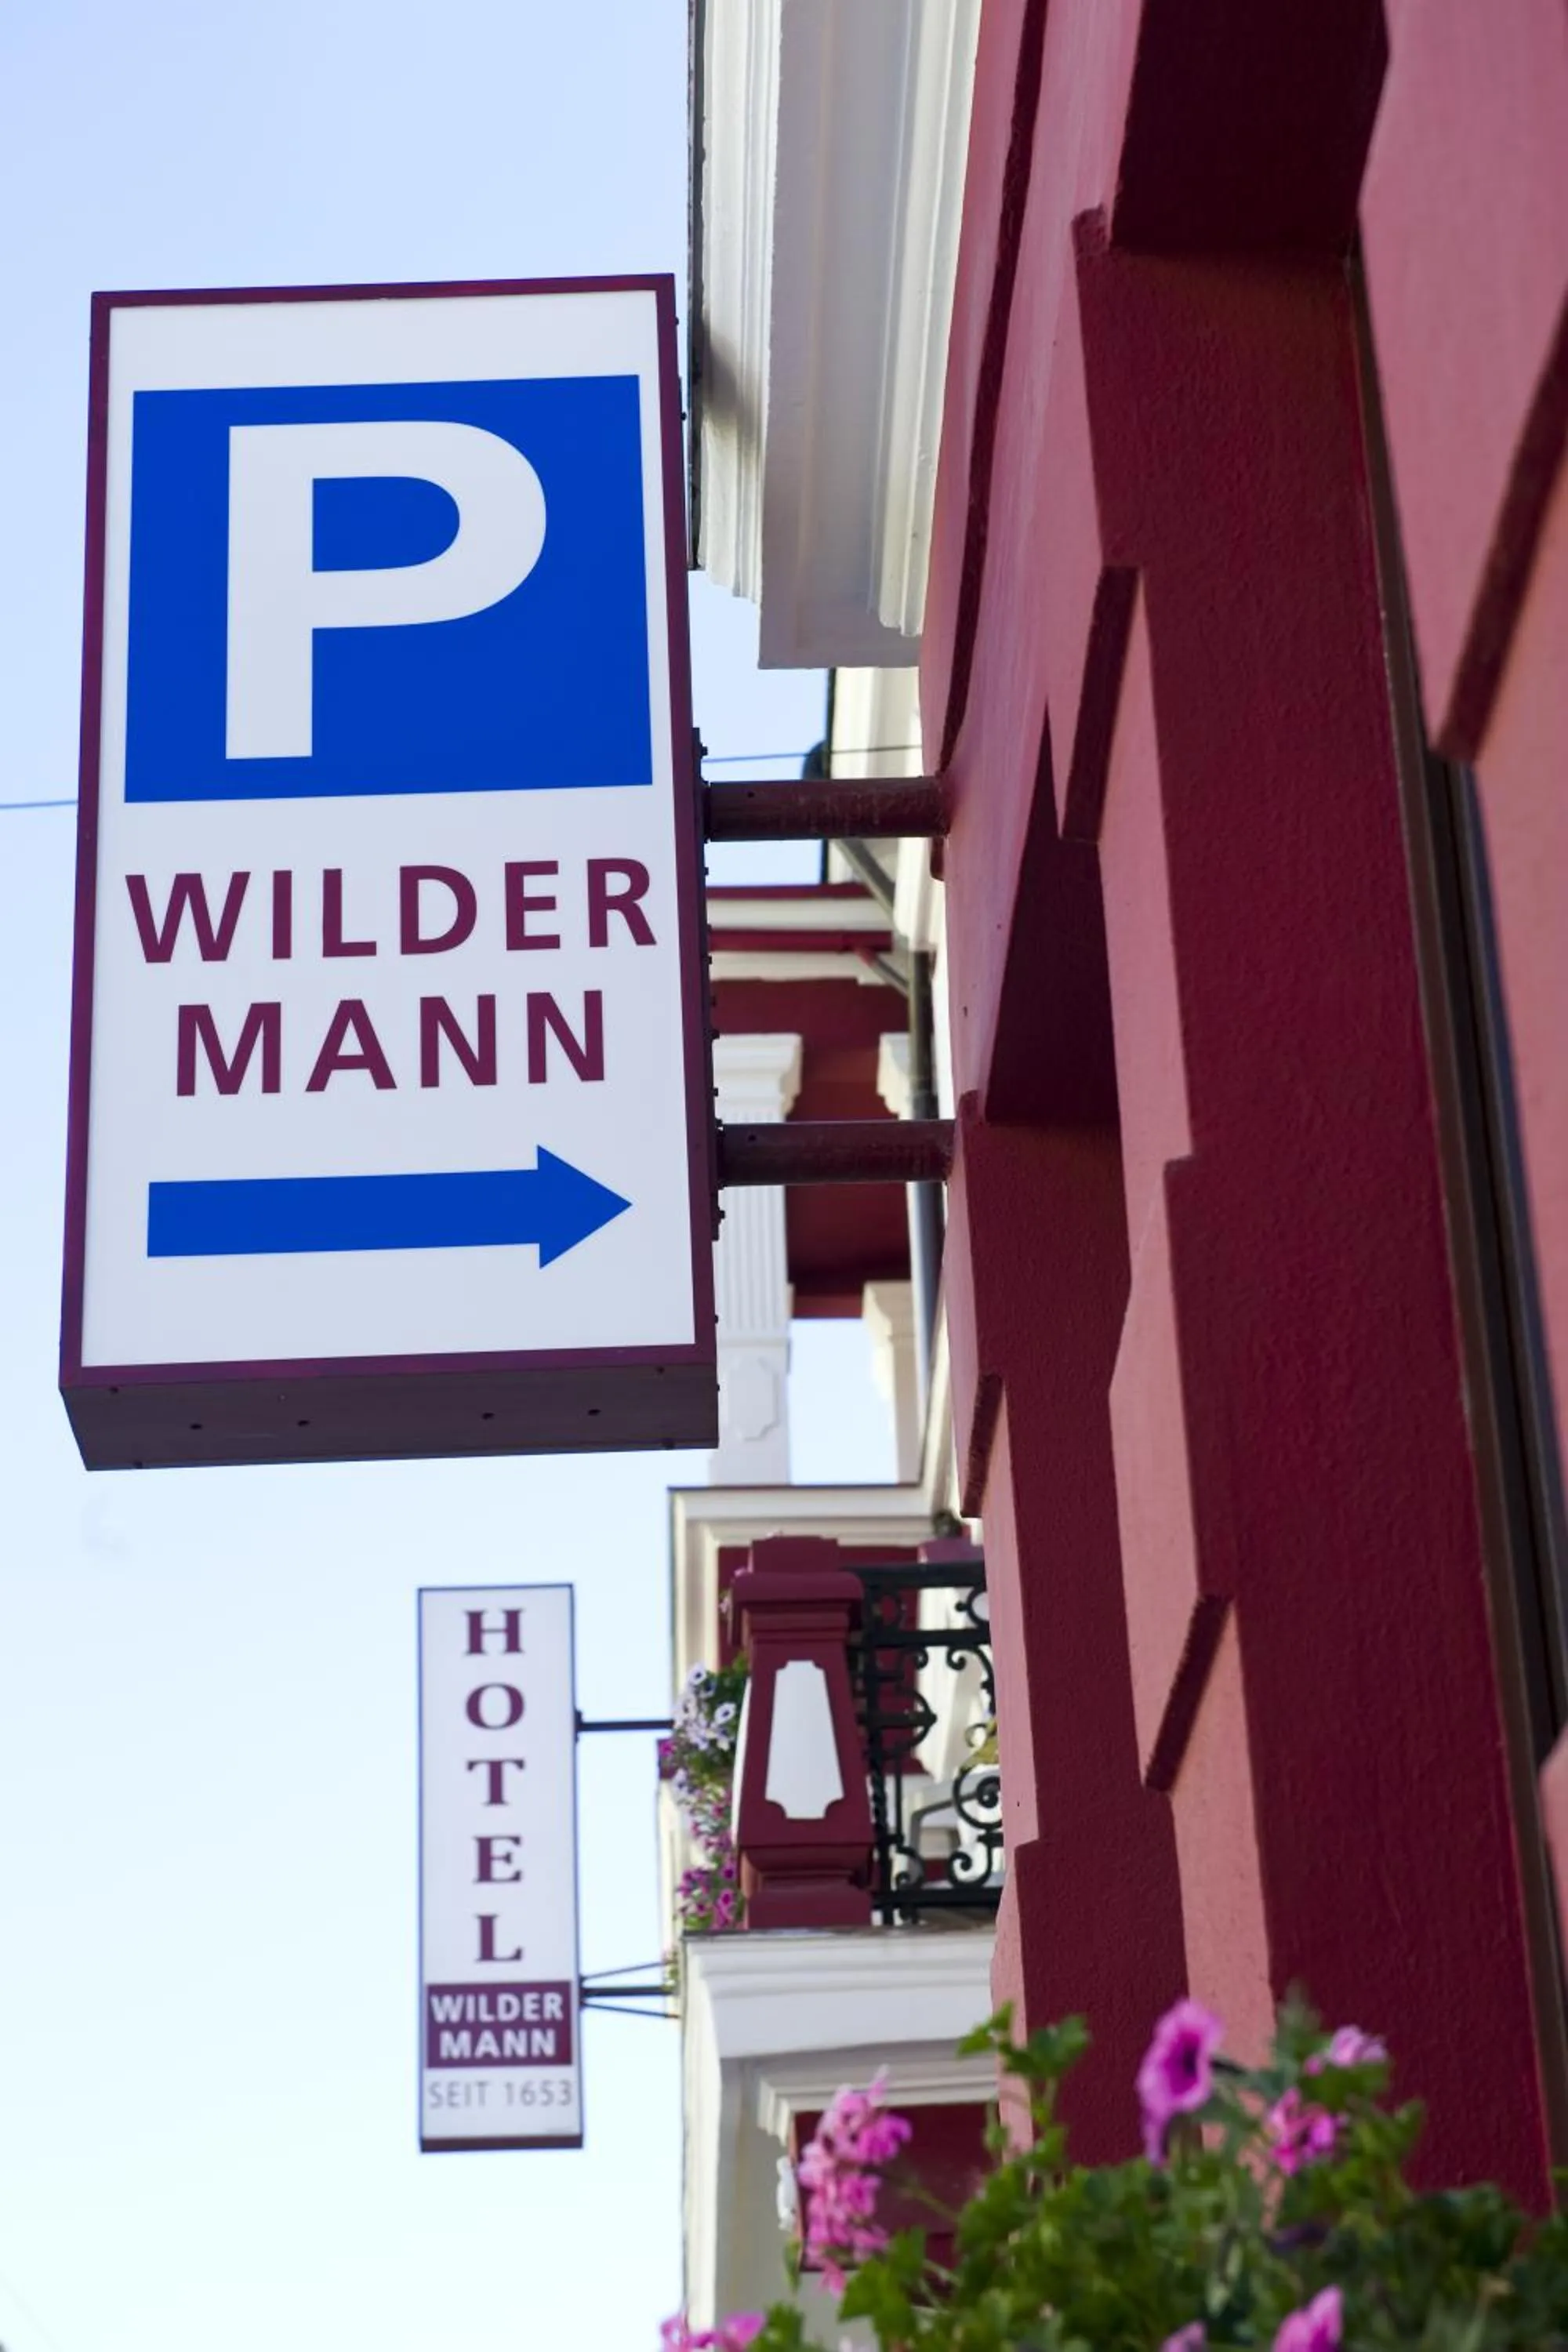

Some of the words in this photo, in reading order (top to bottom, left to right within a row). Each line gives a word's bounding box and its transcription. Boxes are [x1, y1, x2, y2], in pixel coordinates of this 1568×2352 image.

[225, 421, 546, 760] P
[125, 858, 657, 964] WILDER
[176, 989, 605, 1097] MANN
[463, 1608, 524, 1963] HOTEL
[430, 1991, 564, 2024] WILDER
[439, 2028, 555, 2059] MANN
[428, 2080, 489, 2109] SEIT
[504, 2078, 573, 2107] 1653
